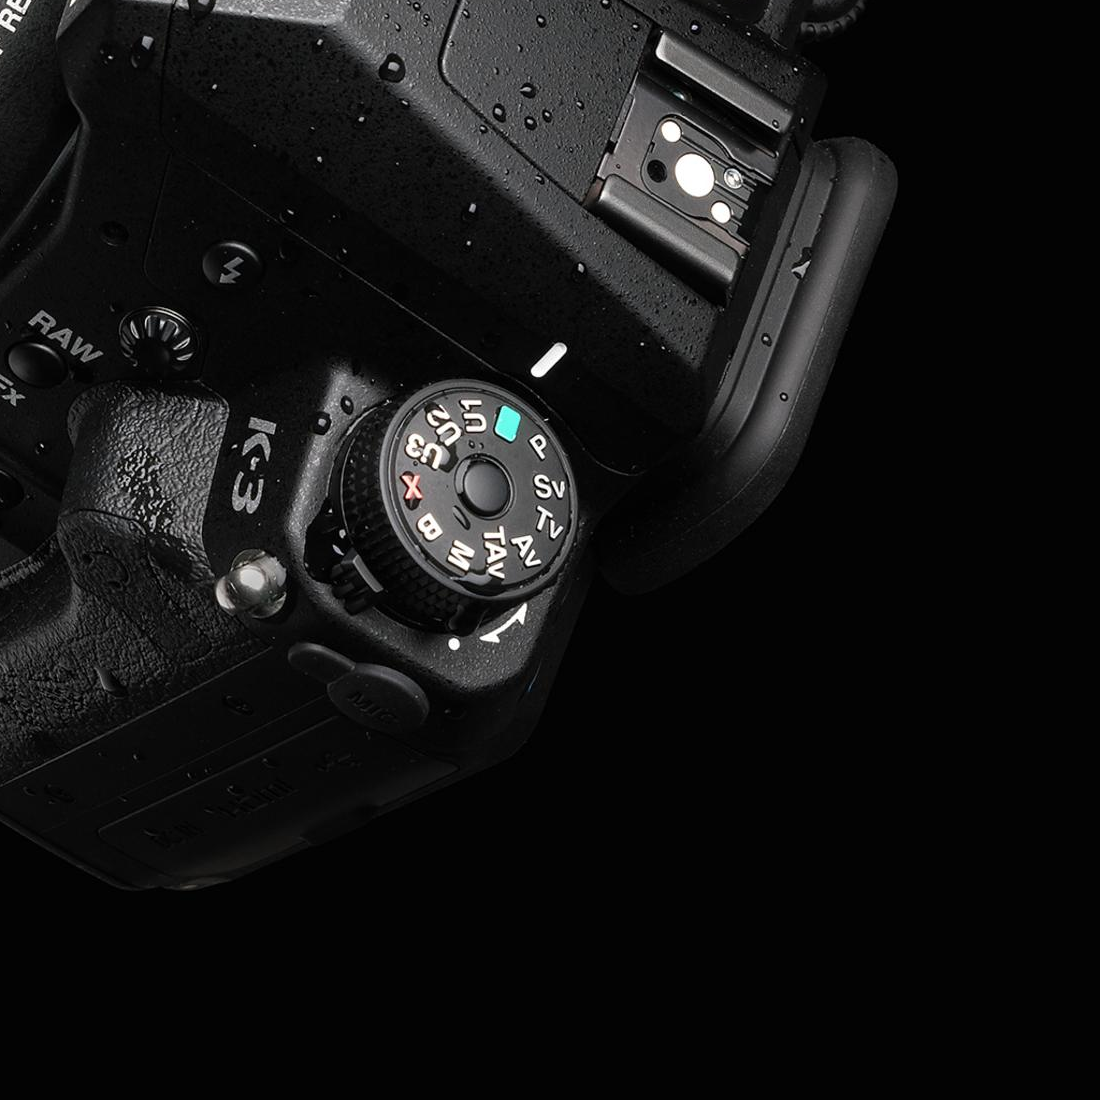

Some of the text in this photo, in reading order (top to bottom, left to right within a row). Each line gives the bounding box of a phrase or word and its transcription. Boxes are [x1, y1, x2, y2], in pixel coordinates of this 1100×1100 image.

[28, 309, 103, 365] RAW
[427, 404, 463, 446] U2
[460, 399, 487, 433] U1
[404, 433, 443, 469] U3
[528, 434, 548, 460] P
[231, 416, 277, 515] K-3
[401, 472, 423, 500] X
[416, 512, 443, 542] B
[447, 539, 475, 575] M
